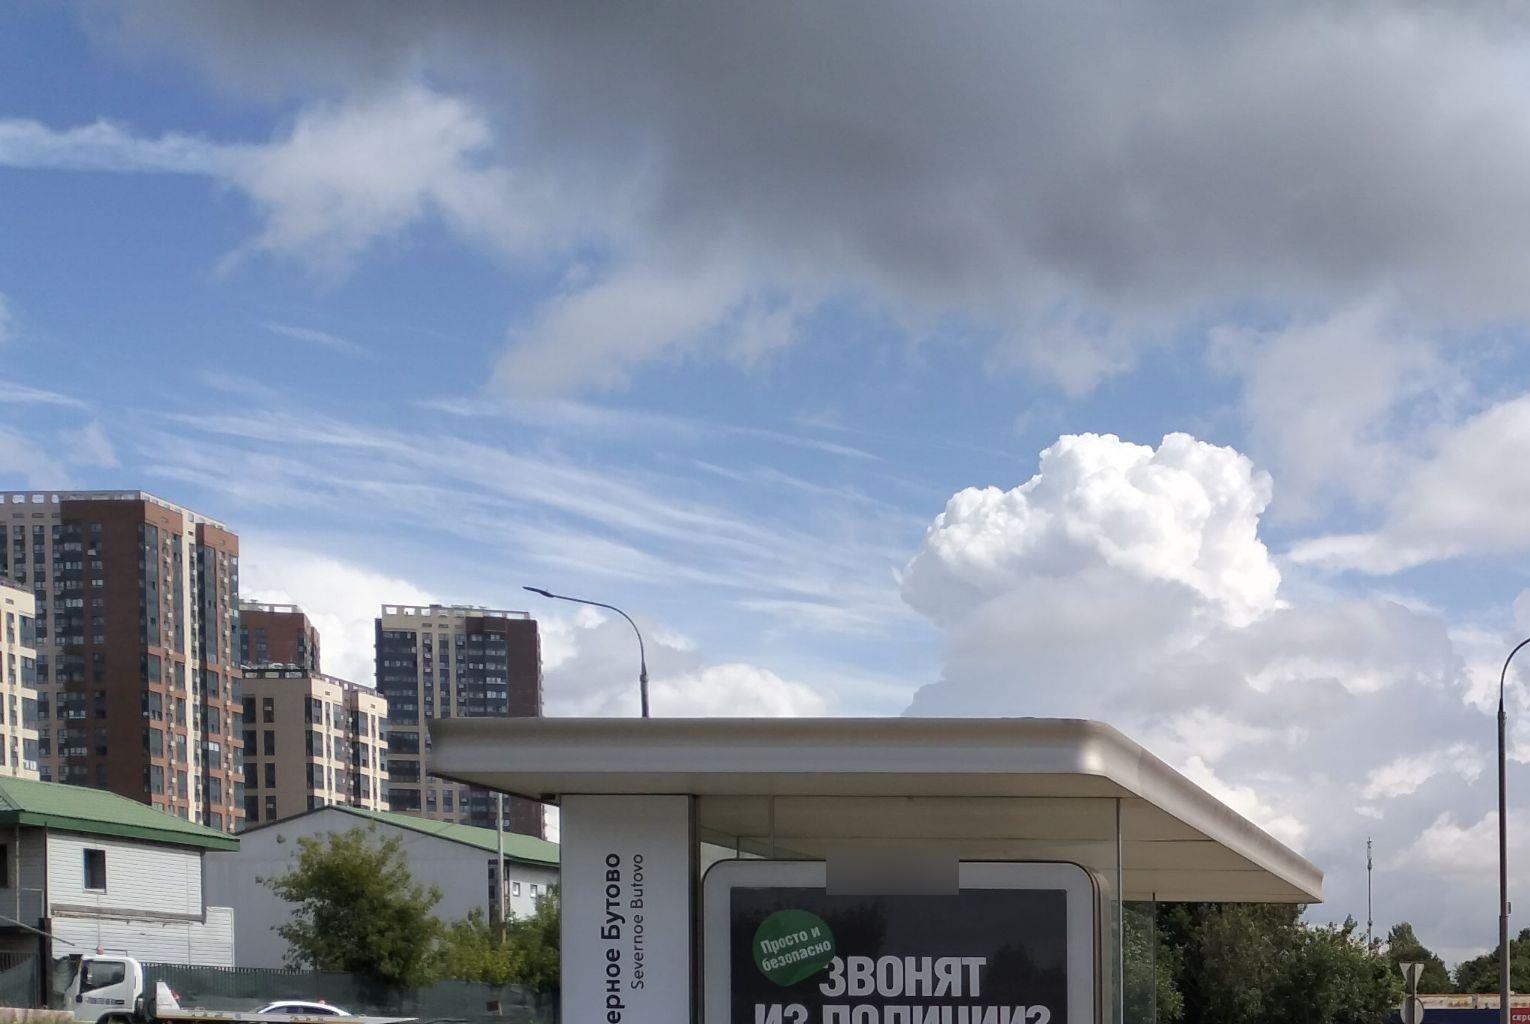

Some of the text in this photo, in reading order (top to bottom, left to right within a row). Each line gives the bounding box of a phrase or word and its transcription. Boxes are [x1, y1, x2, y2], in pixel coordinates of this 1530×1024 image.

[600, 853, 626, 940] Бутово
[630, 854, 644, 990] Severnoe Butovo
[760, 926, 821, 955] Просто и
[761, 939, 832, 973] безопасно
[819, 955, 987, 997] ЗВОНЯТ
